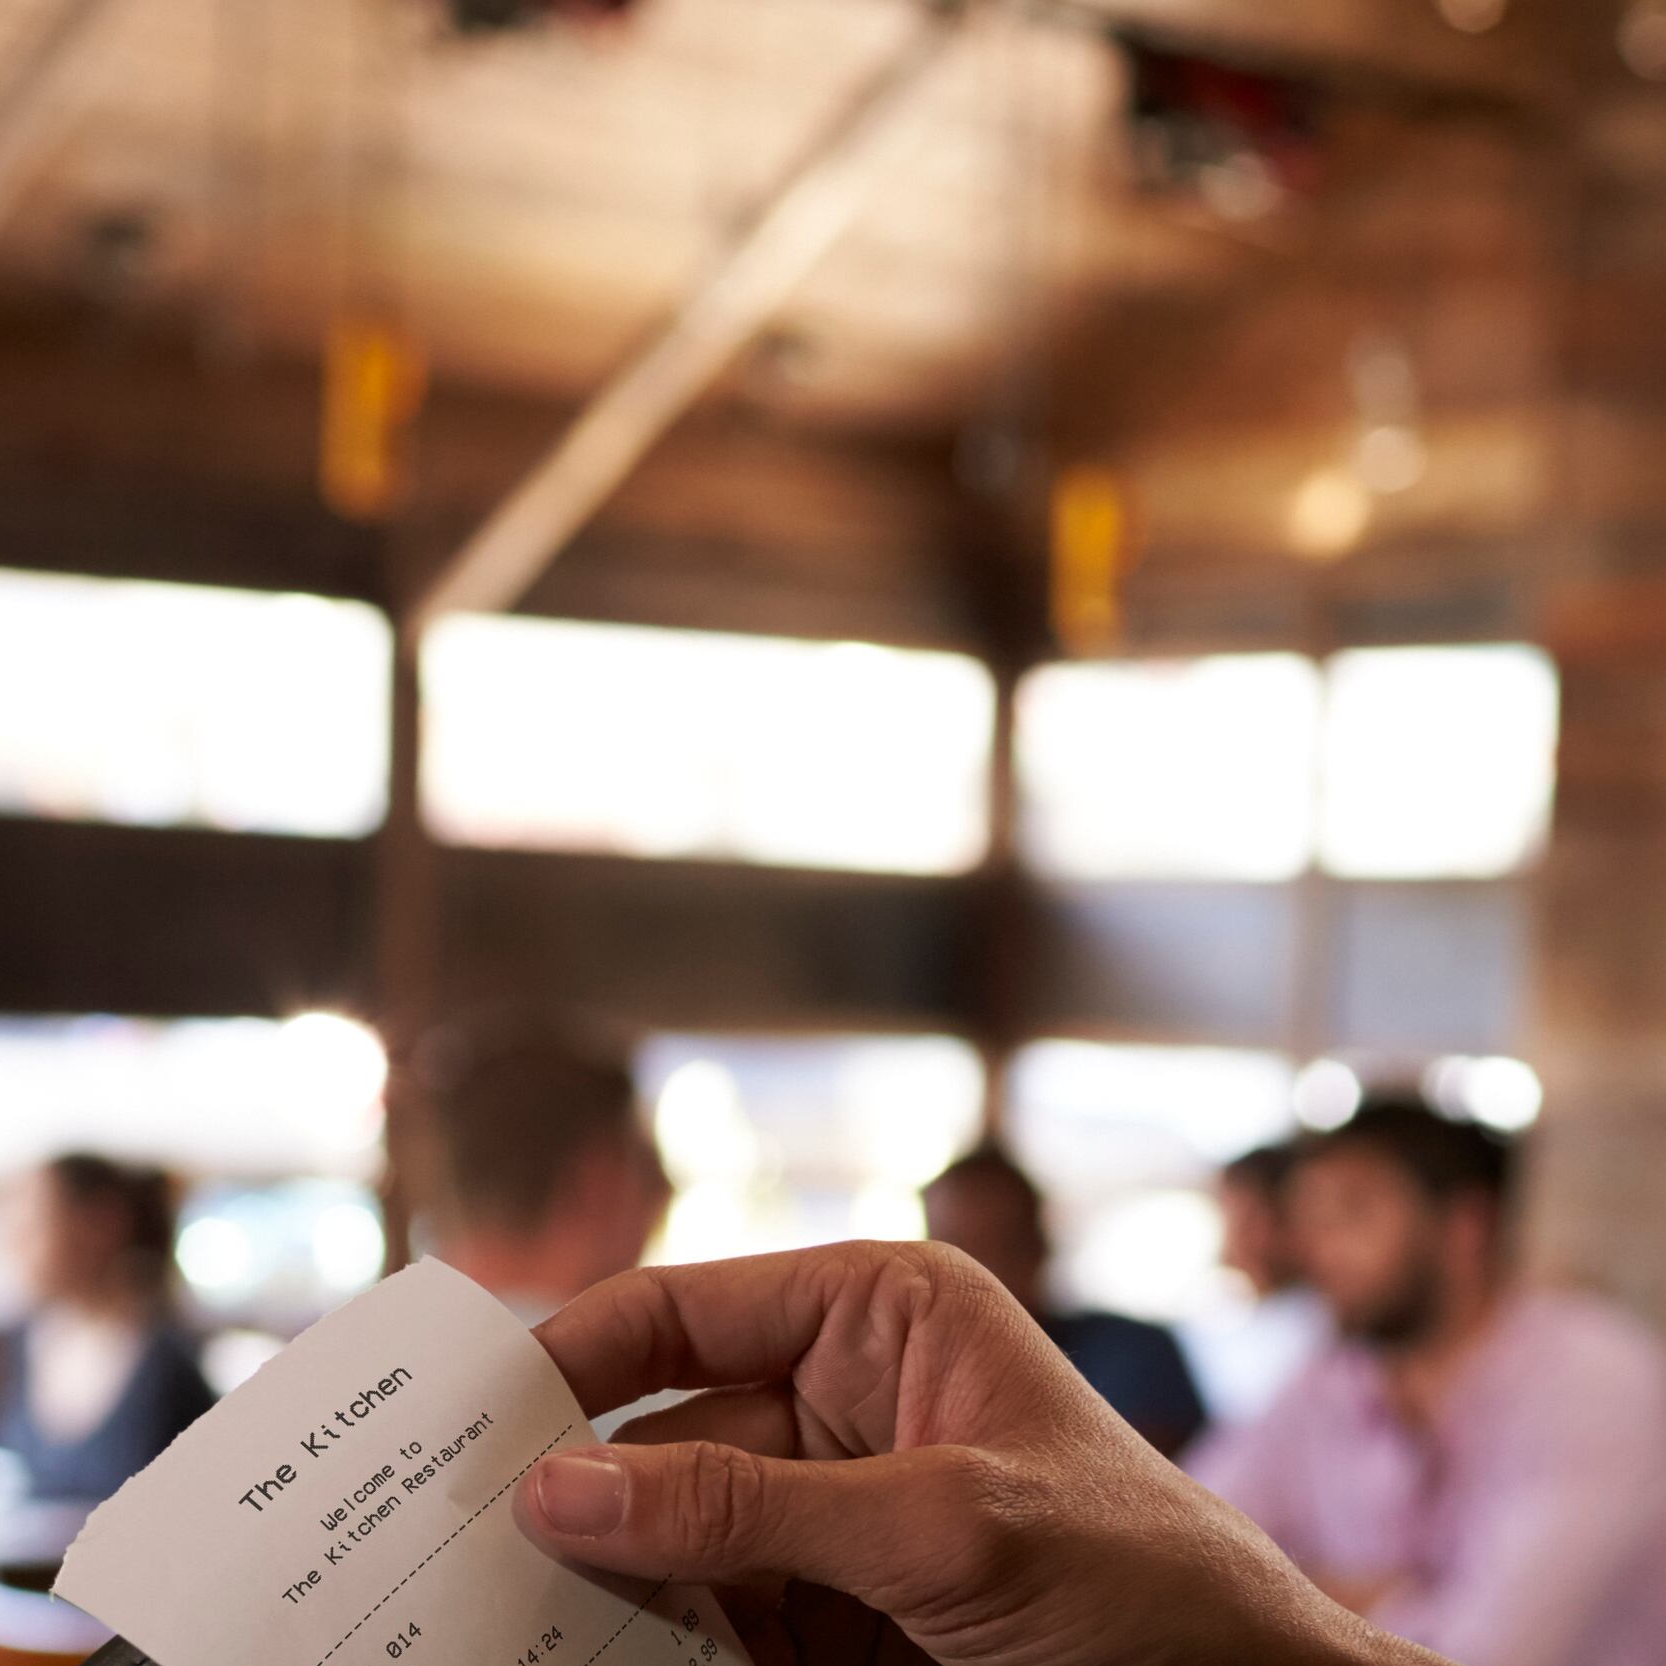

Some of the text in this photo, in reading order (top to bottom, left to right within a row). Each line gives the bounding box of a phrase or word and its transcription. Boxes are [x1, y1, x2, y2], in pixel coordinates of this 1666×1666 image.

[238, 1367, 412, 1512] The Kitchen
[282, 1412, 493, 1604] The Kitchen Restaurant
[320, 1441, 422, 1531] Welcome to
[386, 1622, 422, 1658] 014
[670, 1608, 700, 1646] 1.89
